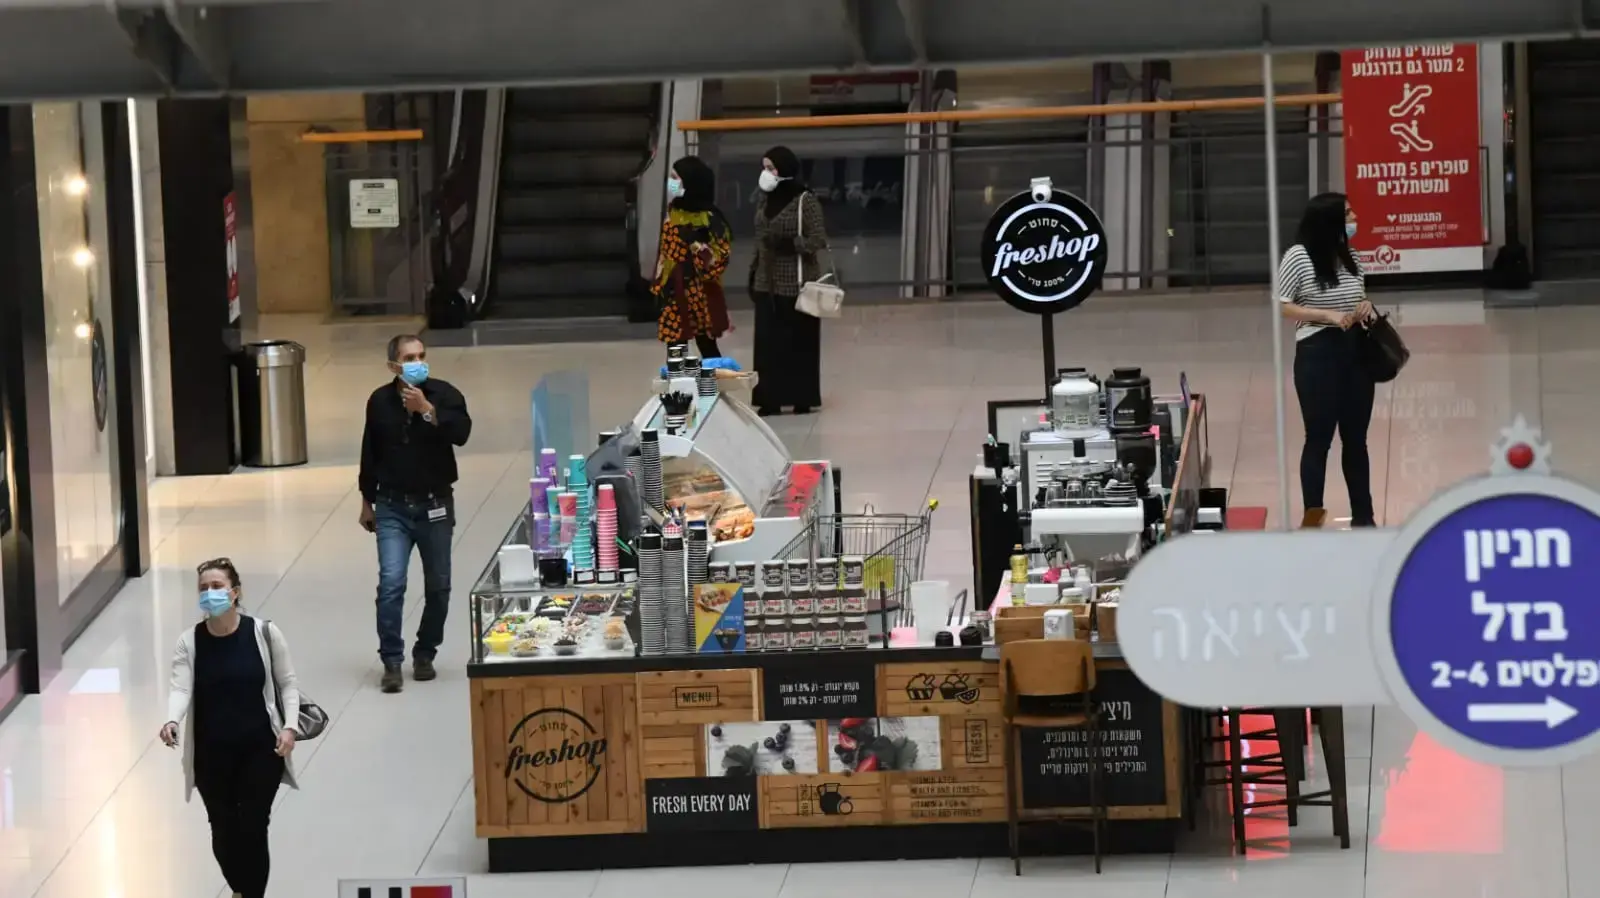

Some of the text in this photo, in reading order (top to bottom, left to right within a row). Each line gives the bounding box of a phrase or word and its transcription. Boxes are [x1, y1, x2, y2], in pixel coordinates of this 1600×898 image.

[1352, 57, 1465, 77] 2 מטר גם בדרגנוע
[1357, 159, 1469, 179] סופרים 5 מדרגות
[1377, 178, 1449, 196] ומשתלבים
[1028, 217, 1059, 229] סחוט
[991, 233, 1100, 277] freshop
[1043, 276, 1065, 287] 100%
[1464, 528, 1571, 583] חניון
[1471, 590, 1568, 641] בזל
[1152, 605, 1336, 661] יציאה
[1431, 653, 1600, 688] פלסים 2-4
[682, 692, 712, 703] MENU
[970, 723, 983, 758] FRESH
[504, 738, 608, 778] freshop
[652, 793, 751, 814] FRESH EVERY DAY
